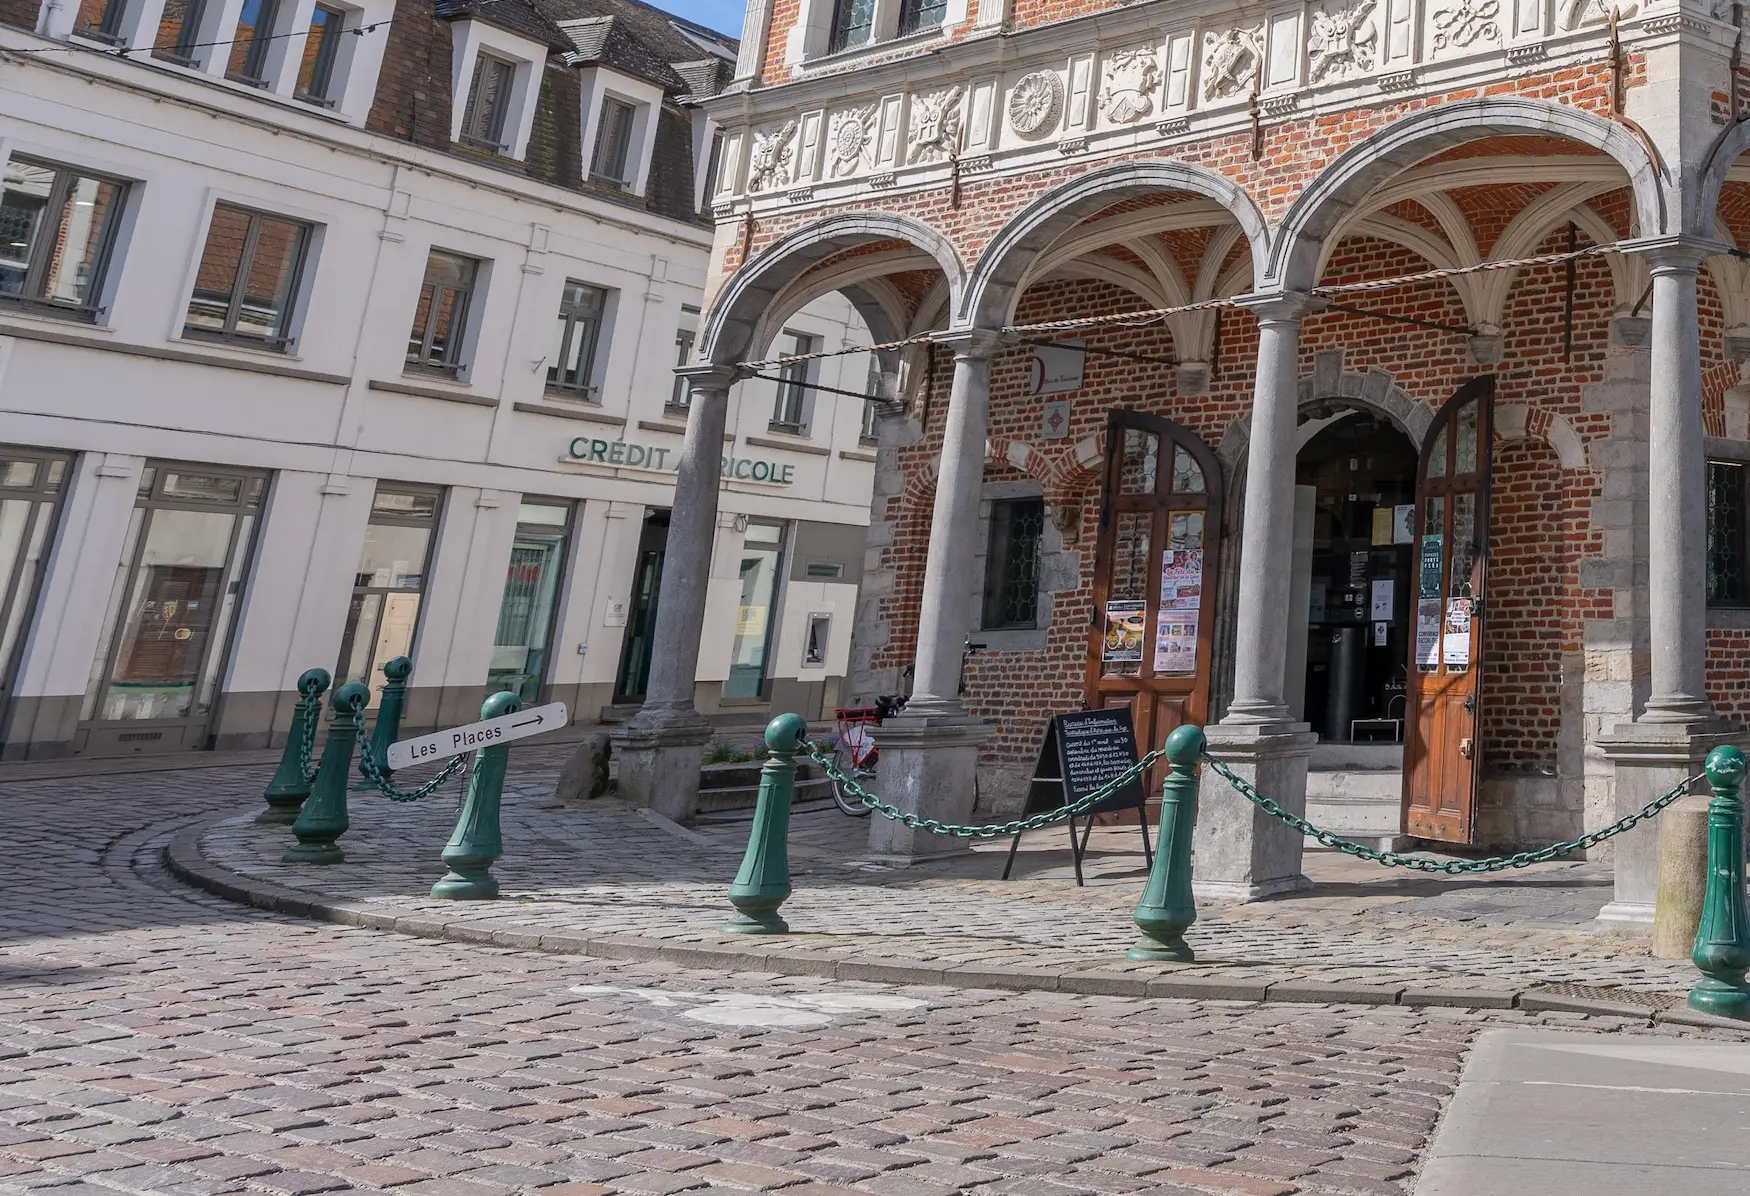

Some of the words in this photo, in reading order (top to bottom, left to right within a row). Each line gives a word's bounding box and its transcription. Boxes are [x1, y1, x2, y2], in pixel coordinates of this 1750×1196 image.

[569, 434, 671, 470] CRÉDIT
[411, 742, 436, 759] Les
[453, 726, 502, 748] Places
